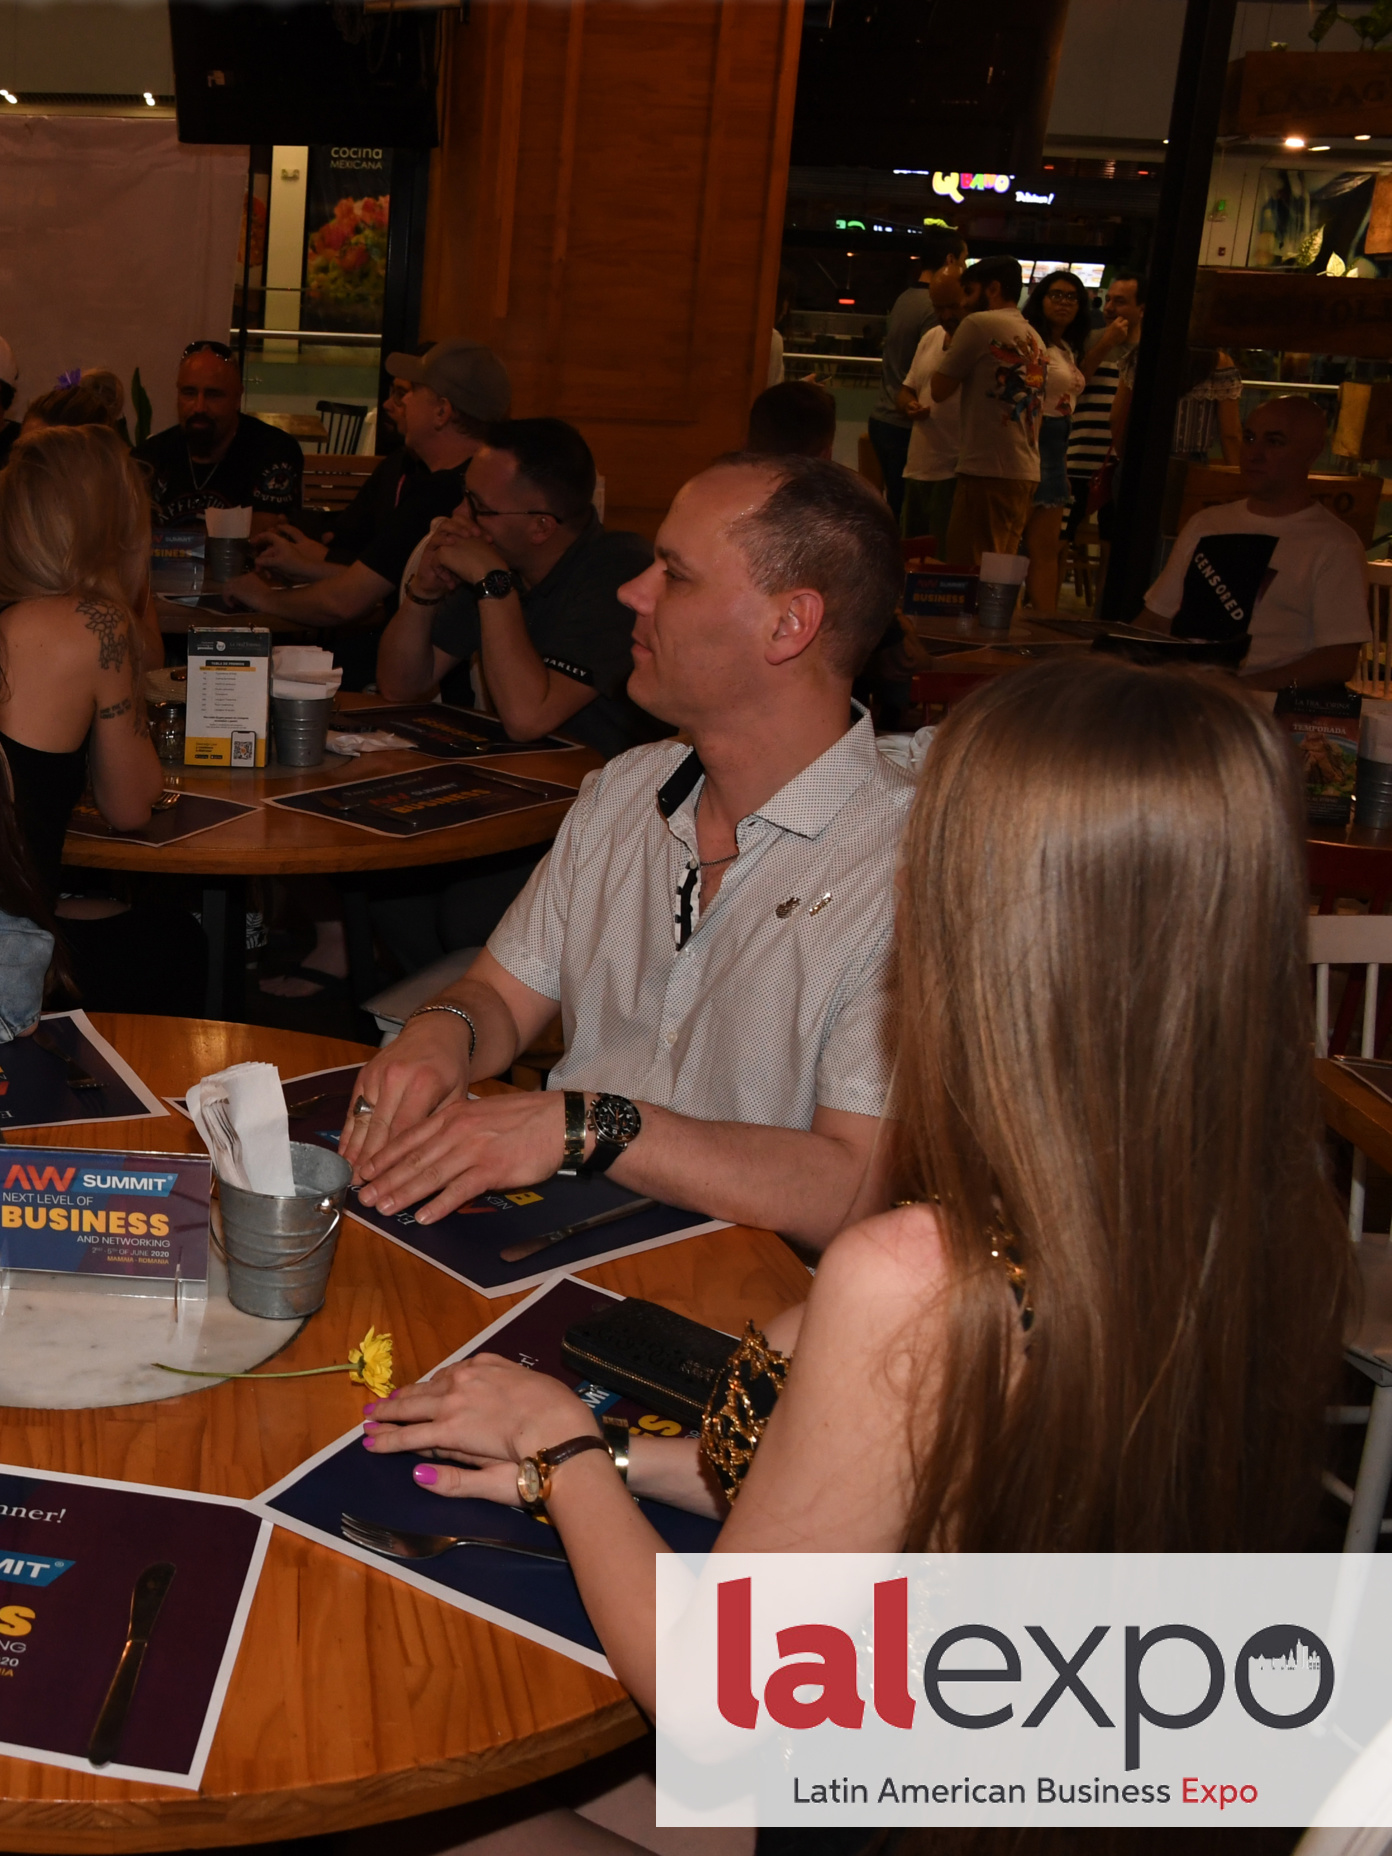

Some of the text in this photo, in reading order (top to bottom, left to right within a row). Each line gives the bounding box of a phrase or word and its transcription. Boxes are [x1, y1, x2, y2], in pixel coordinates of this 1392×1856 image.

[330, 147, 383, 159] cocina
[330, 160, 383, 169] MEXICANA
[1194, 552, 1244, 621] CENSORED
[543, 657, 587, 677] OAKLEY
[2, 1192, 94, 1206] NEXT LEVEL OF
[1, 1205, 170, 1236] BUSINESS
[77, 1235, 170, 1247] AND NETWORKING
[130, 1249, 149, 1257] JUNE
[151, 1250, 170, 1258] 2020
[138, 1257, 170, 1265] ROMANIA
